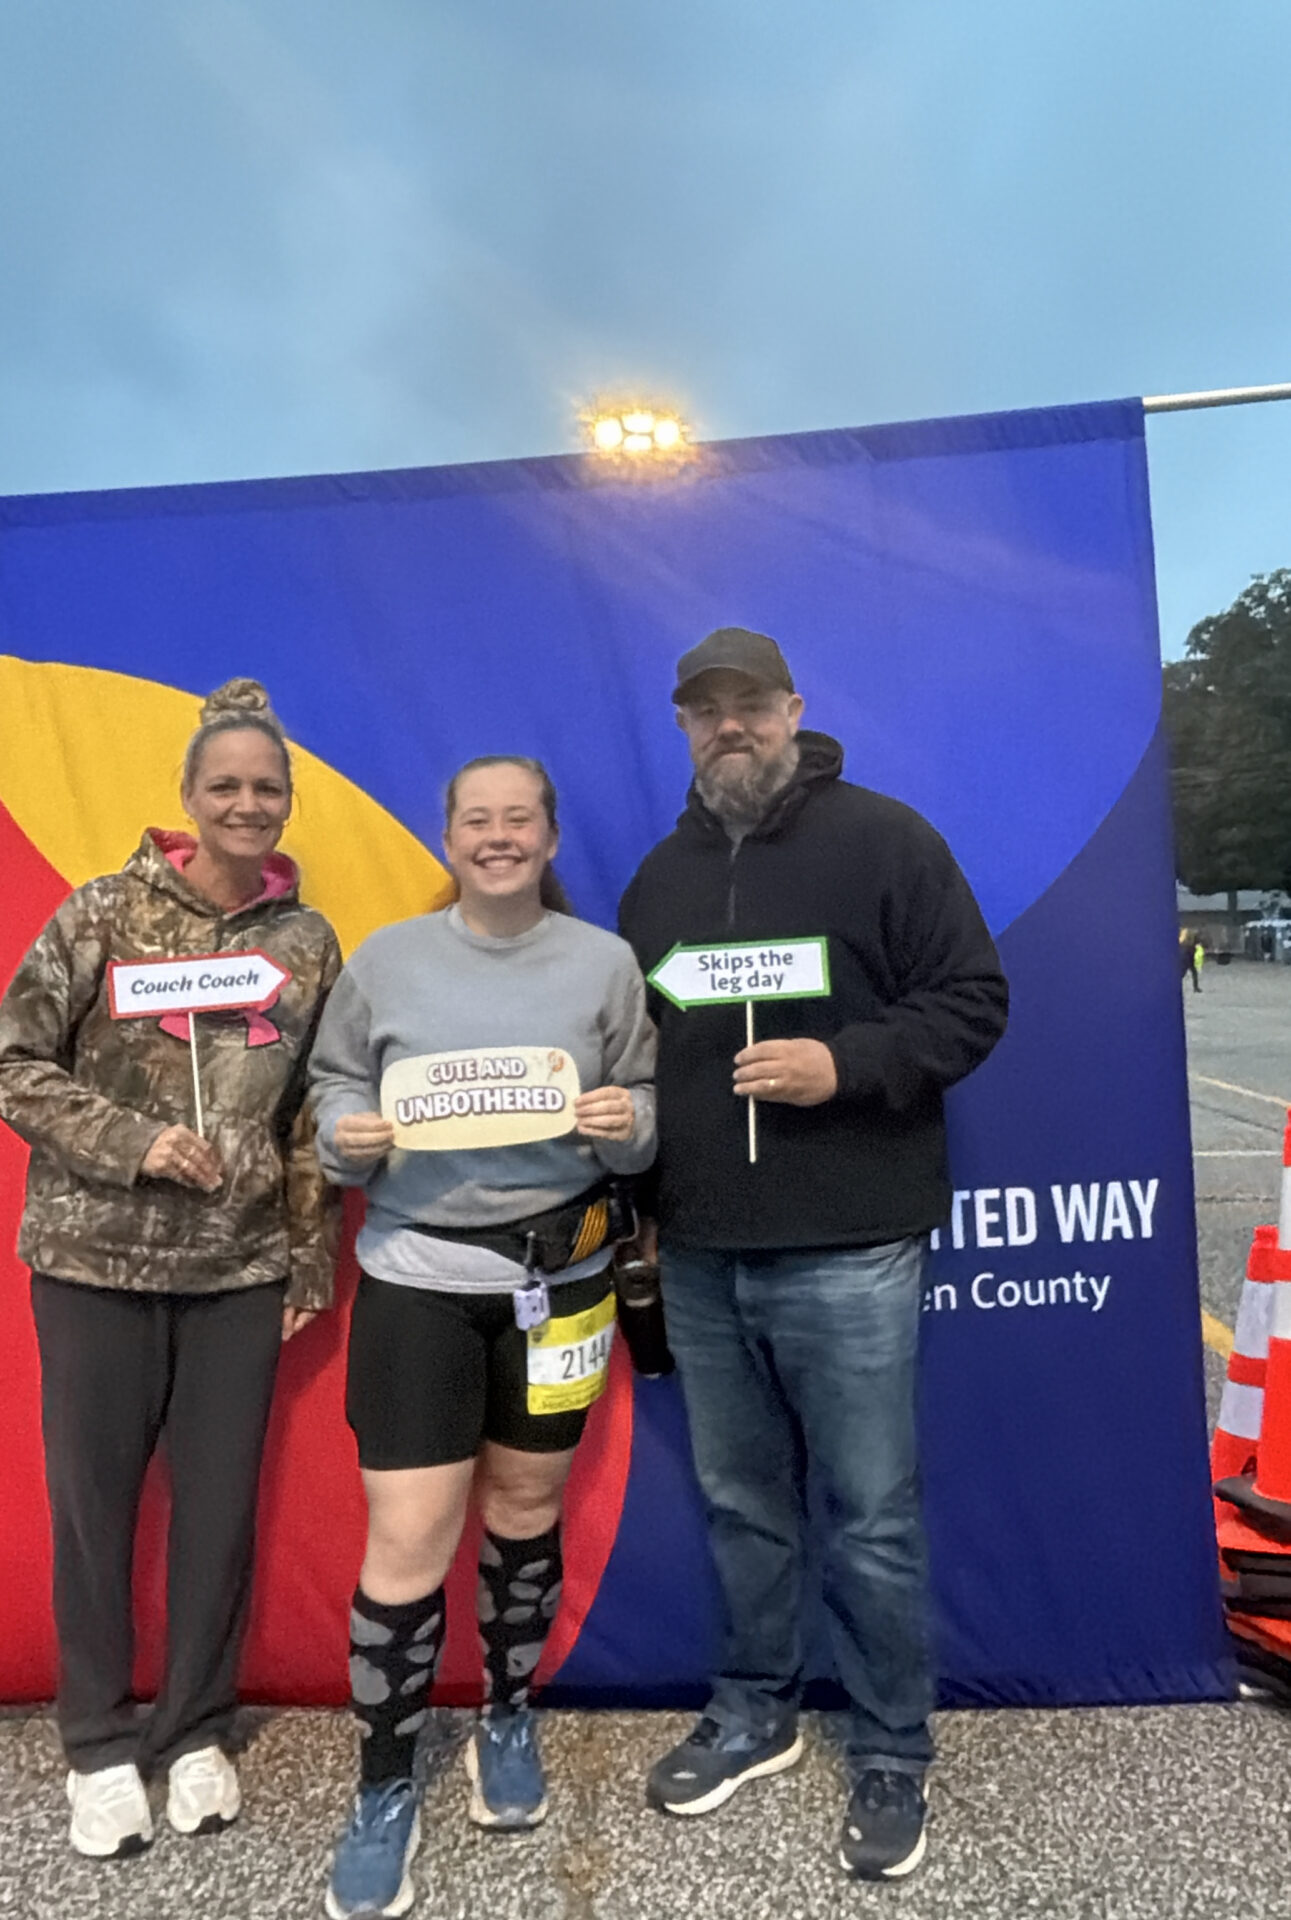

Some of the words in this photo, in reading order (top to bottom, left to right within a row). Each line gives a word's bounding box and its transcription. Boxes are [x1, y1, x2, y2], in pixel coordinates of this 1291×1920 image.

[698, 953, 754, 973] Skips
[759, 950, 793, 967] the
[131, 976, 192, 995] Couch
[198, 970, 260, 989] Coach
[711, 973, 742, 994] leg
[747, 971, 784, 990] day
[427, 1059, 478, 1085] CUTE
[478, 1057, 527, 1081] AND
[396, 1086, 566, 1125] UNBOTHERED
[1051, 1178, 1159, 1243] WAY
[971, 1271, 1111, 1312] County
